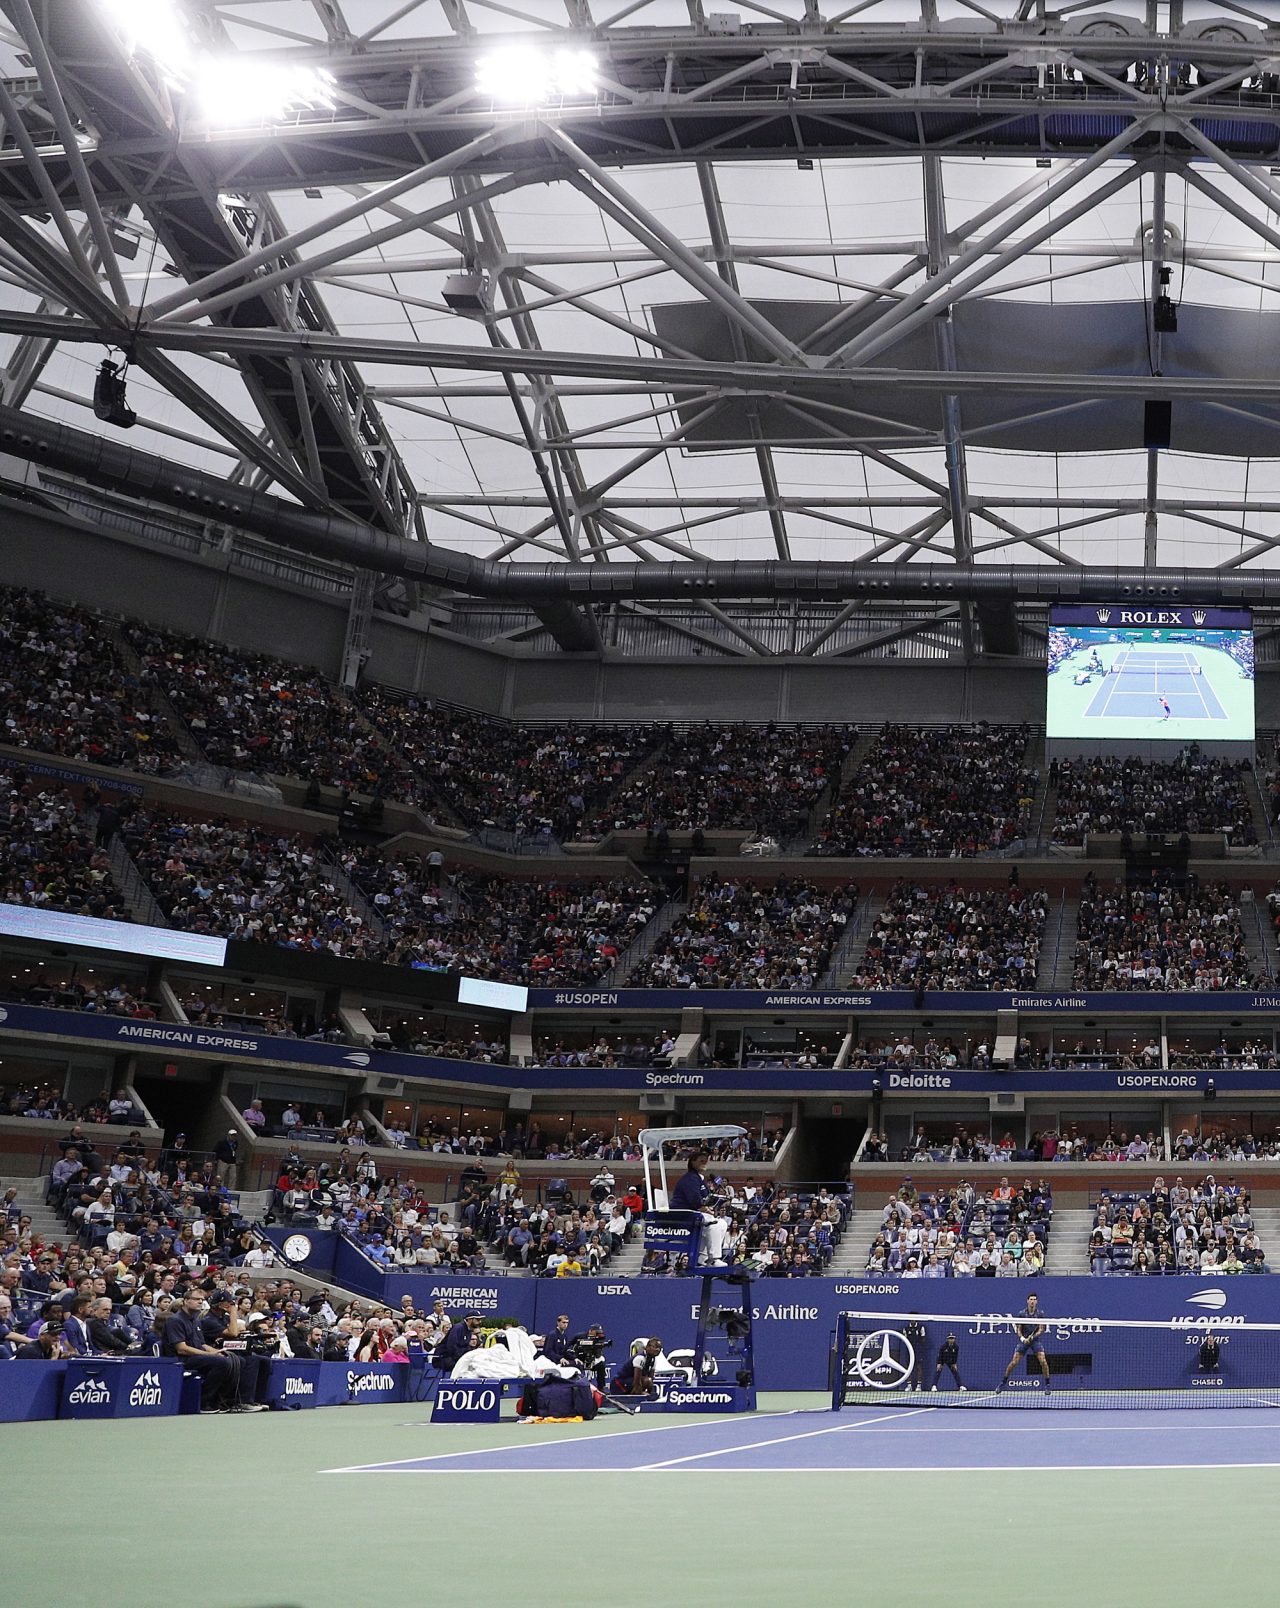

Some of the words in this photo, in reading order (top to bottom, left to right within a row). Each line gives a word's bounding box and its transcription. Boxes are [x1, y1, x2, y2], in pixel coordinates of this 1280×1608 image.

[1120, 612, 1182, 624] ROLEX
[59, 770, 80, 782] TEXT
[554, 993, 618, 1005] #USOPEN
[766, 996, 820, 1005] AMERICAN
[824, 996, 872, 1006] EXPRESS
[1012, 997, 1052, 1008] Emirates
[1055, 997, 1087, 1008] Airline
[118, 1025, 192, 1043] AMERICAN
[196, 1035, 258, 1050] EXPRESS
[646, 1072, 704, 1086] Spectrum
[890, 1074, 951, 1088] Deloitte
[1117, 1075, 1197, 1087] USOPEN.ORG
[646, 1226, 688, 1237] Spectrum
[430, 1287, 498, 1298] AMERICAN
[598, 1285, 632, 1295] USTA
[835, 1284, 900, 1294] USOPEN.ORG
[440, 1298, 498, 1309] EXPRESS
[764, 1304, 818, 1320] Airline
[1185, 1336, 1200, 1344] 50
[286, 1378, 314, 1395] Wilson
[347, 1370, 392, 1396] Spectrum
[69, 1389, 110, 1404] evian
[130, 1384, 162, 1406] evian
[436, 1390, 496, 1411] POLO
[669, 1391, 728, 1406] Spectrum
